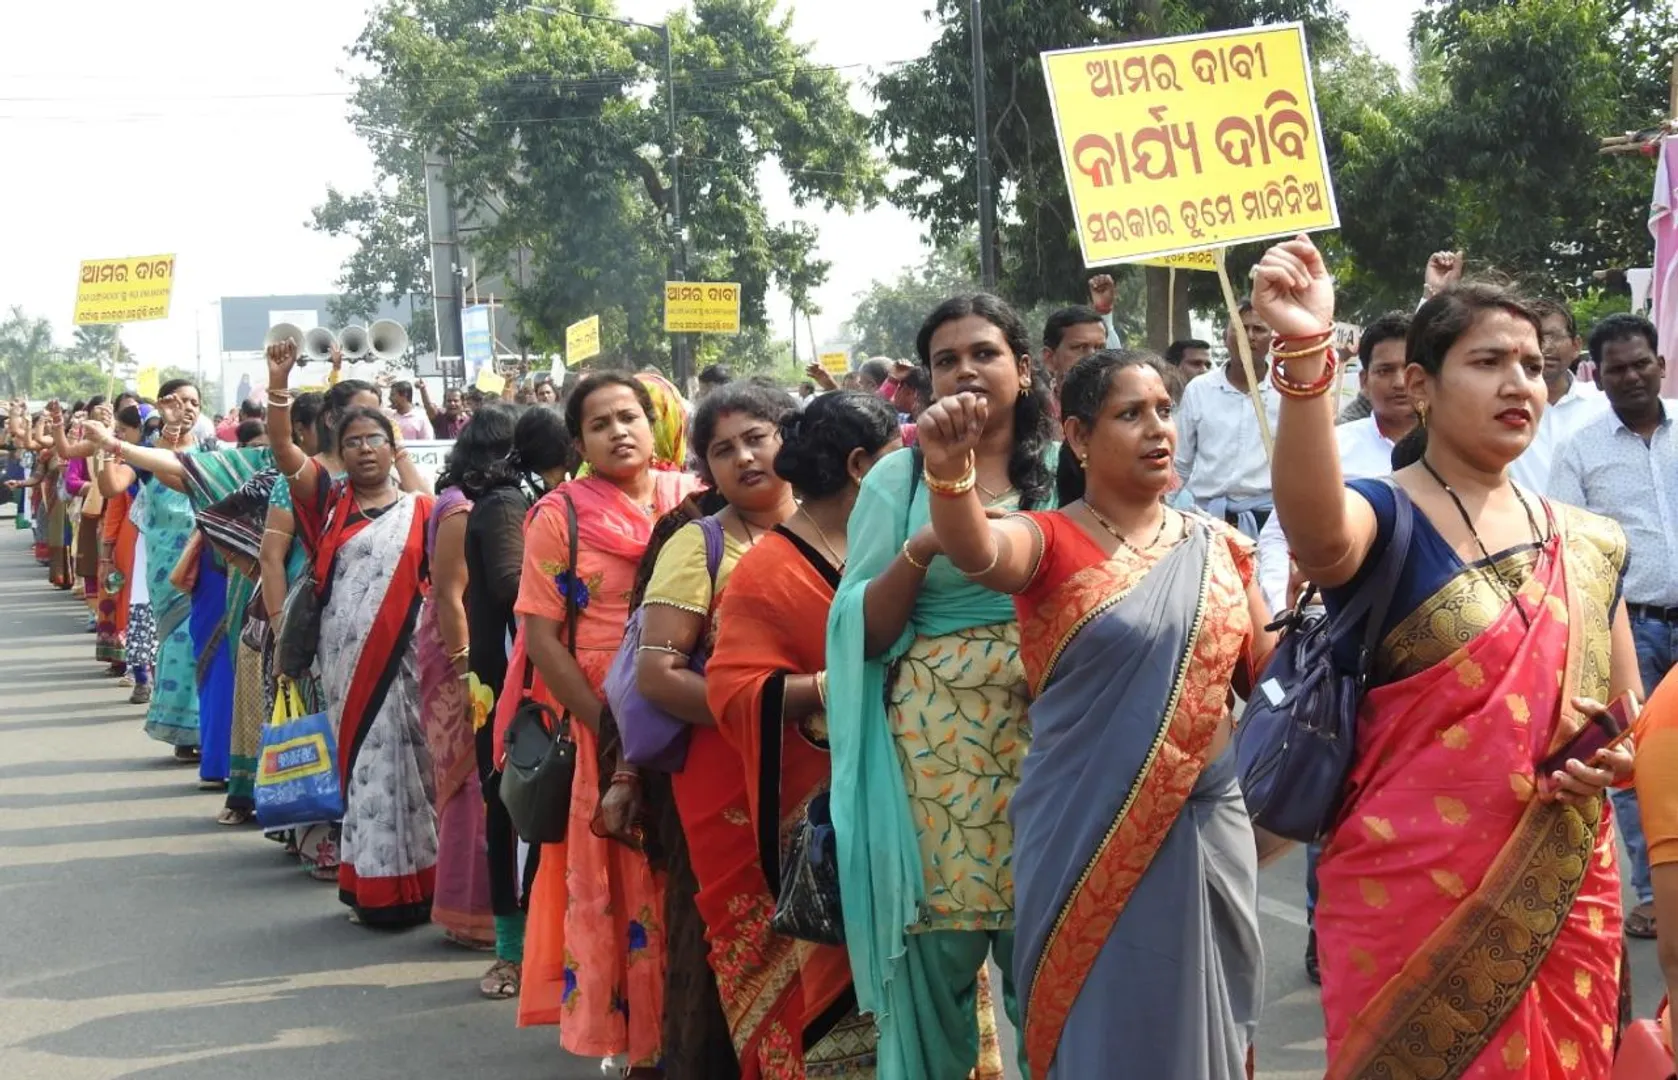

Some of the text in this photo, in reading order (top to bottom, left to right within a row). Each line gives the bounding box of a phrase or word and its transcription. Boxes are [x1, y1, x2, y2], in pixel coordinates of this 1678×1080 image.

[1086, 42, 1267, 97] ଆମର ଦାବୀ
[1073, 89, 1309, 187] କାର୍ଯ୍ୟ ଦାବି
[1087, 204, 1173, 243] ସରକାର
[1180, 194, 1235, 238] ତୁମେ
[82, 259, 173, 283] ଆମର ଦାବୀ
[667, 287, 737, 301] ଆମର ଦାବୀ
